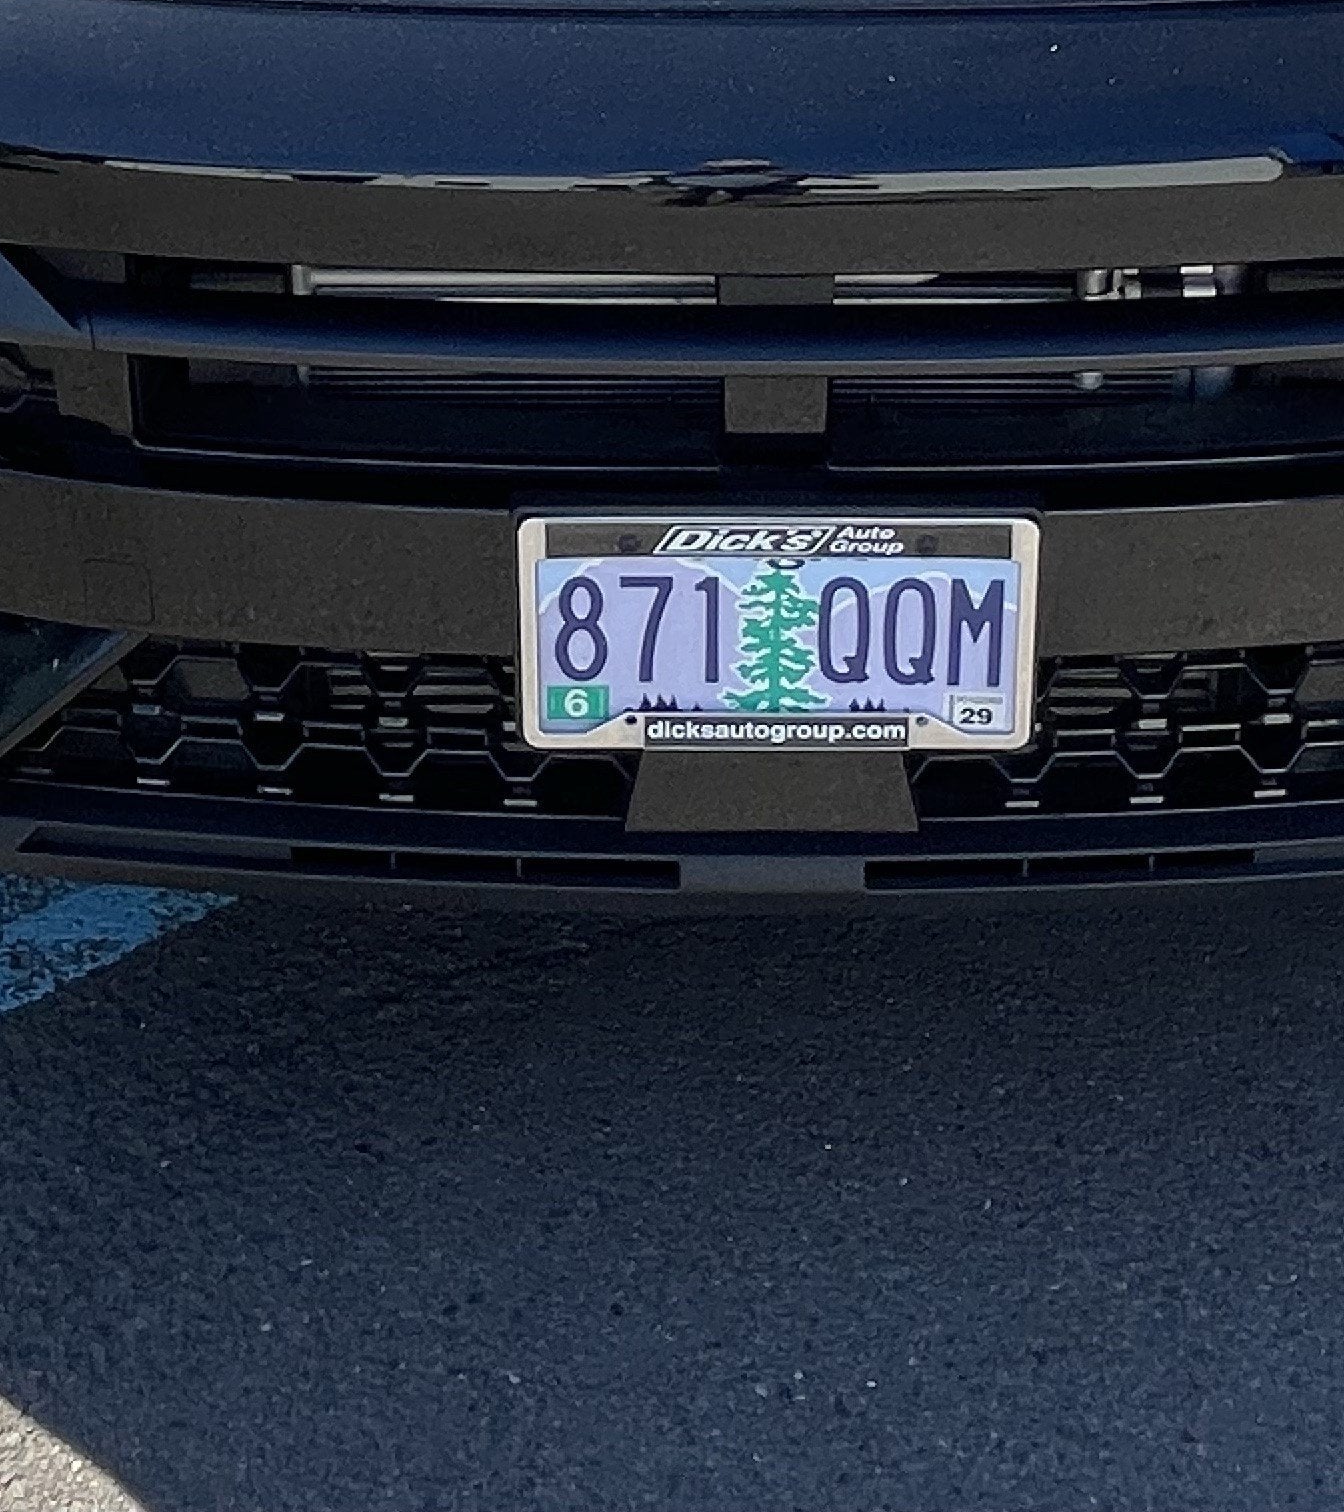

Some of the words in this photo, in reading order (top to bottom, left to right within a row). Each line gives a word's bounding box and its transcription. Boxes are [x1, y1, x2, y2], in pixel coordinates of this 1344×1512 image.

[666, 529, 814, 551] Dick's
[836, 526, 896, 540] Auto
[829, 539, 905, 555] Group
[555, 576, 721, 683] 871
[818, 576, 1006, 687] QQM
[564, 690, 589, 718] 6
[959, 707, 993, 725] 29
[647, 719, 906, 742] dicksautogroup.com
